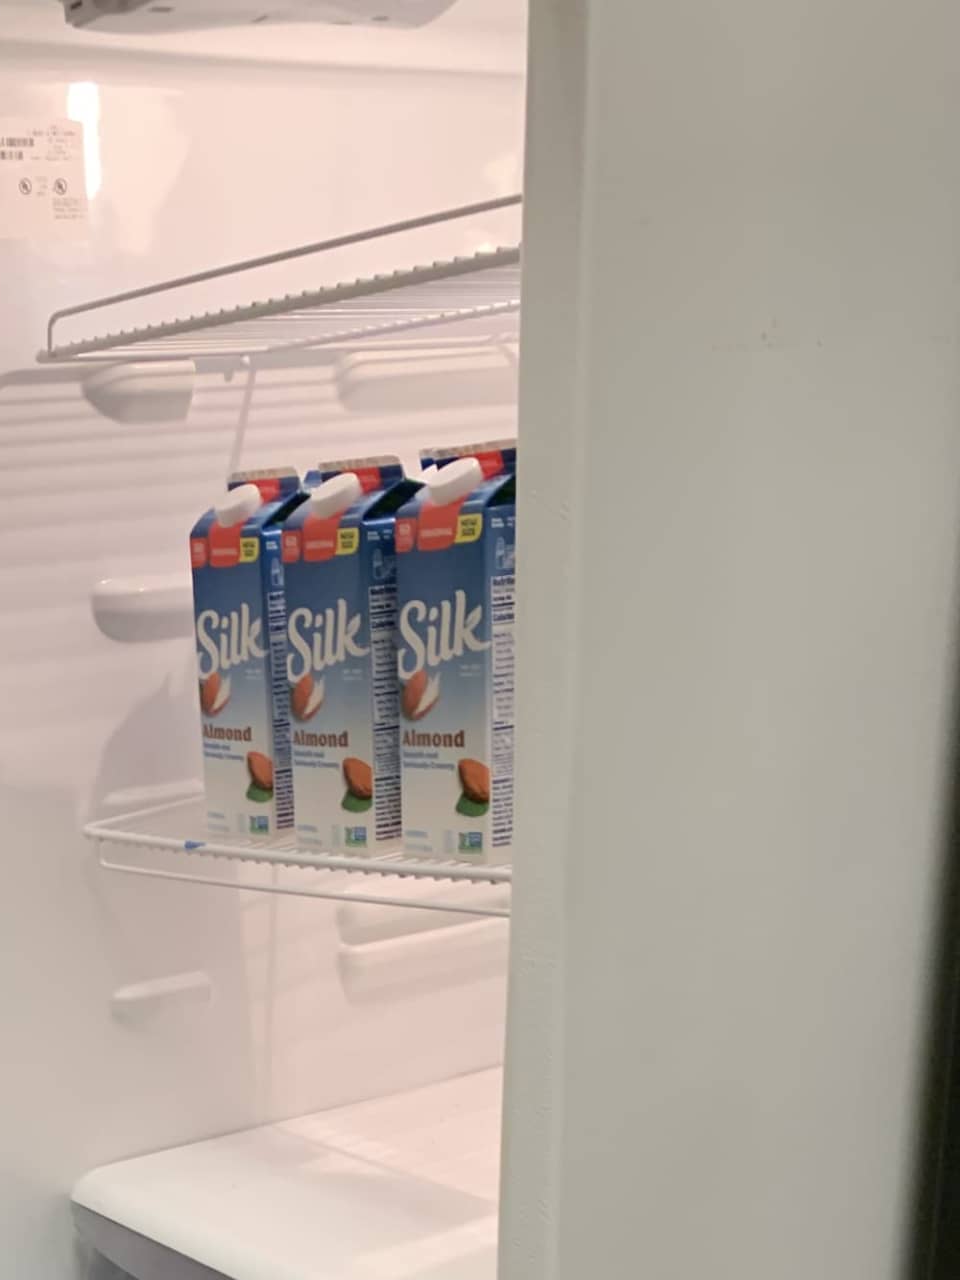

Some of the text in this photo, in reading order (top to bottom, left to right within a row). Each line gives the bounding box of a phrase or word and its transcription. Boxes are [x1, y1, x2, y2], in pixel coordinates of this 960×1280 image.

[197, 602, 269, 680] Silk
[287, 597, 370, 683] Silk
[398, 589, 491, 680] Silk
[203, 724, 252, 742] Almond
[293, 730, 349, 748] Almond
[403, 729, 465, 748] Almond
